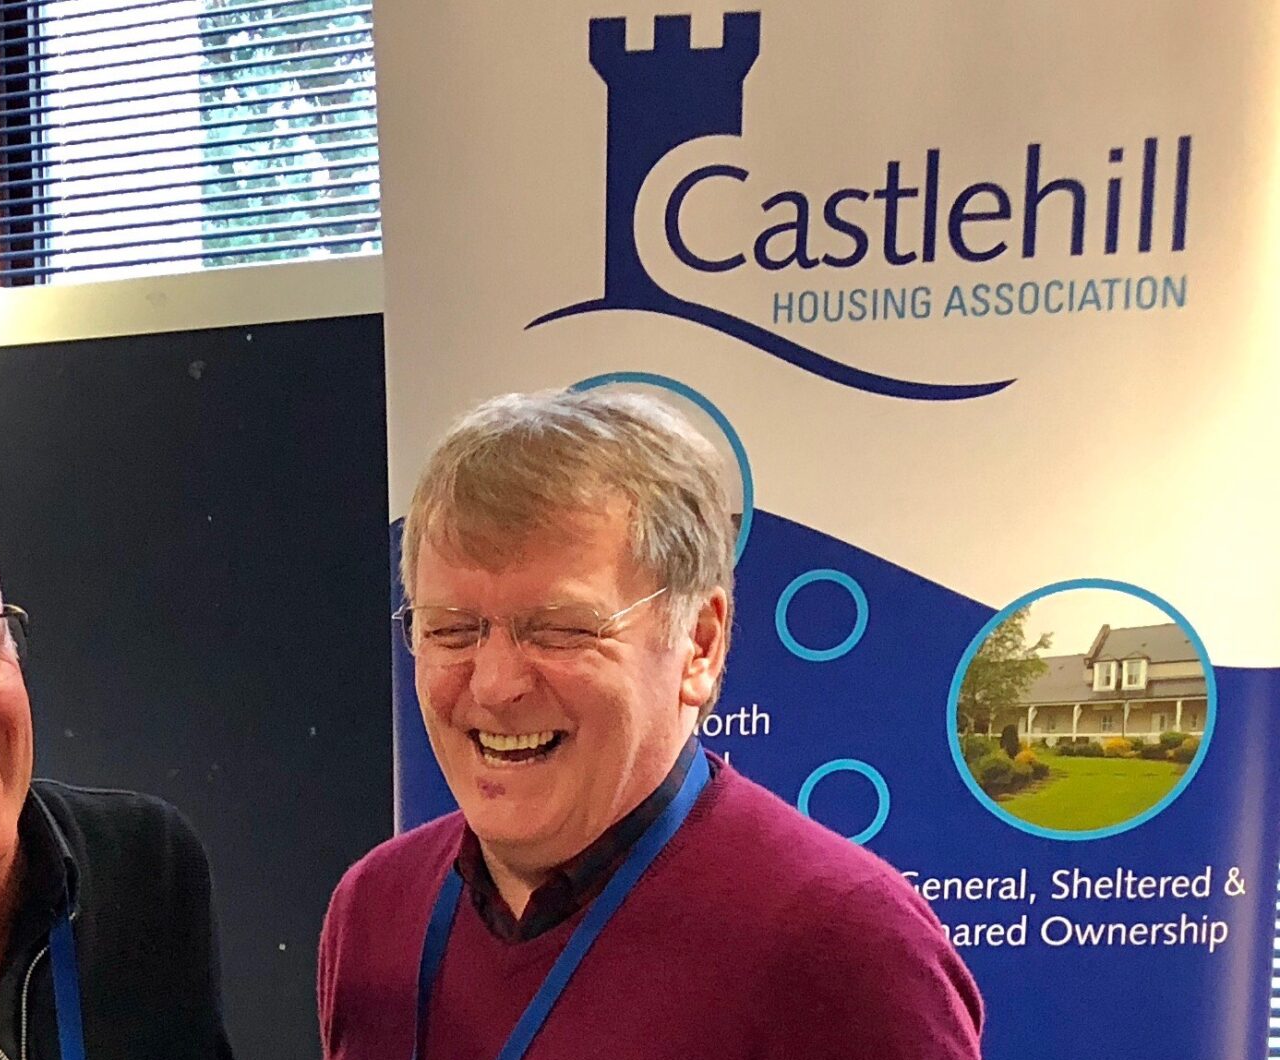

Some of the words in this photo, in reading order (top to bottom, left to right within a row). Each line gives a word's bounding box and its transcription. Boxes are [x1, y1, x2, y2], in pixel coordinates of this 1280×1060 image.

[664, 134, 1193, 273] Castlehill
[773, 284, 931, 325] HOUSING
[943, 275, 1188, 319] ASSOCIATION
[693, 703, 770, 737] orth
[1051, 865, 1211, 899] Sheltered
[1224, 866, 1246, 896] &
[1040, 913, 1228, 953] Ownership
